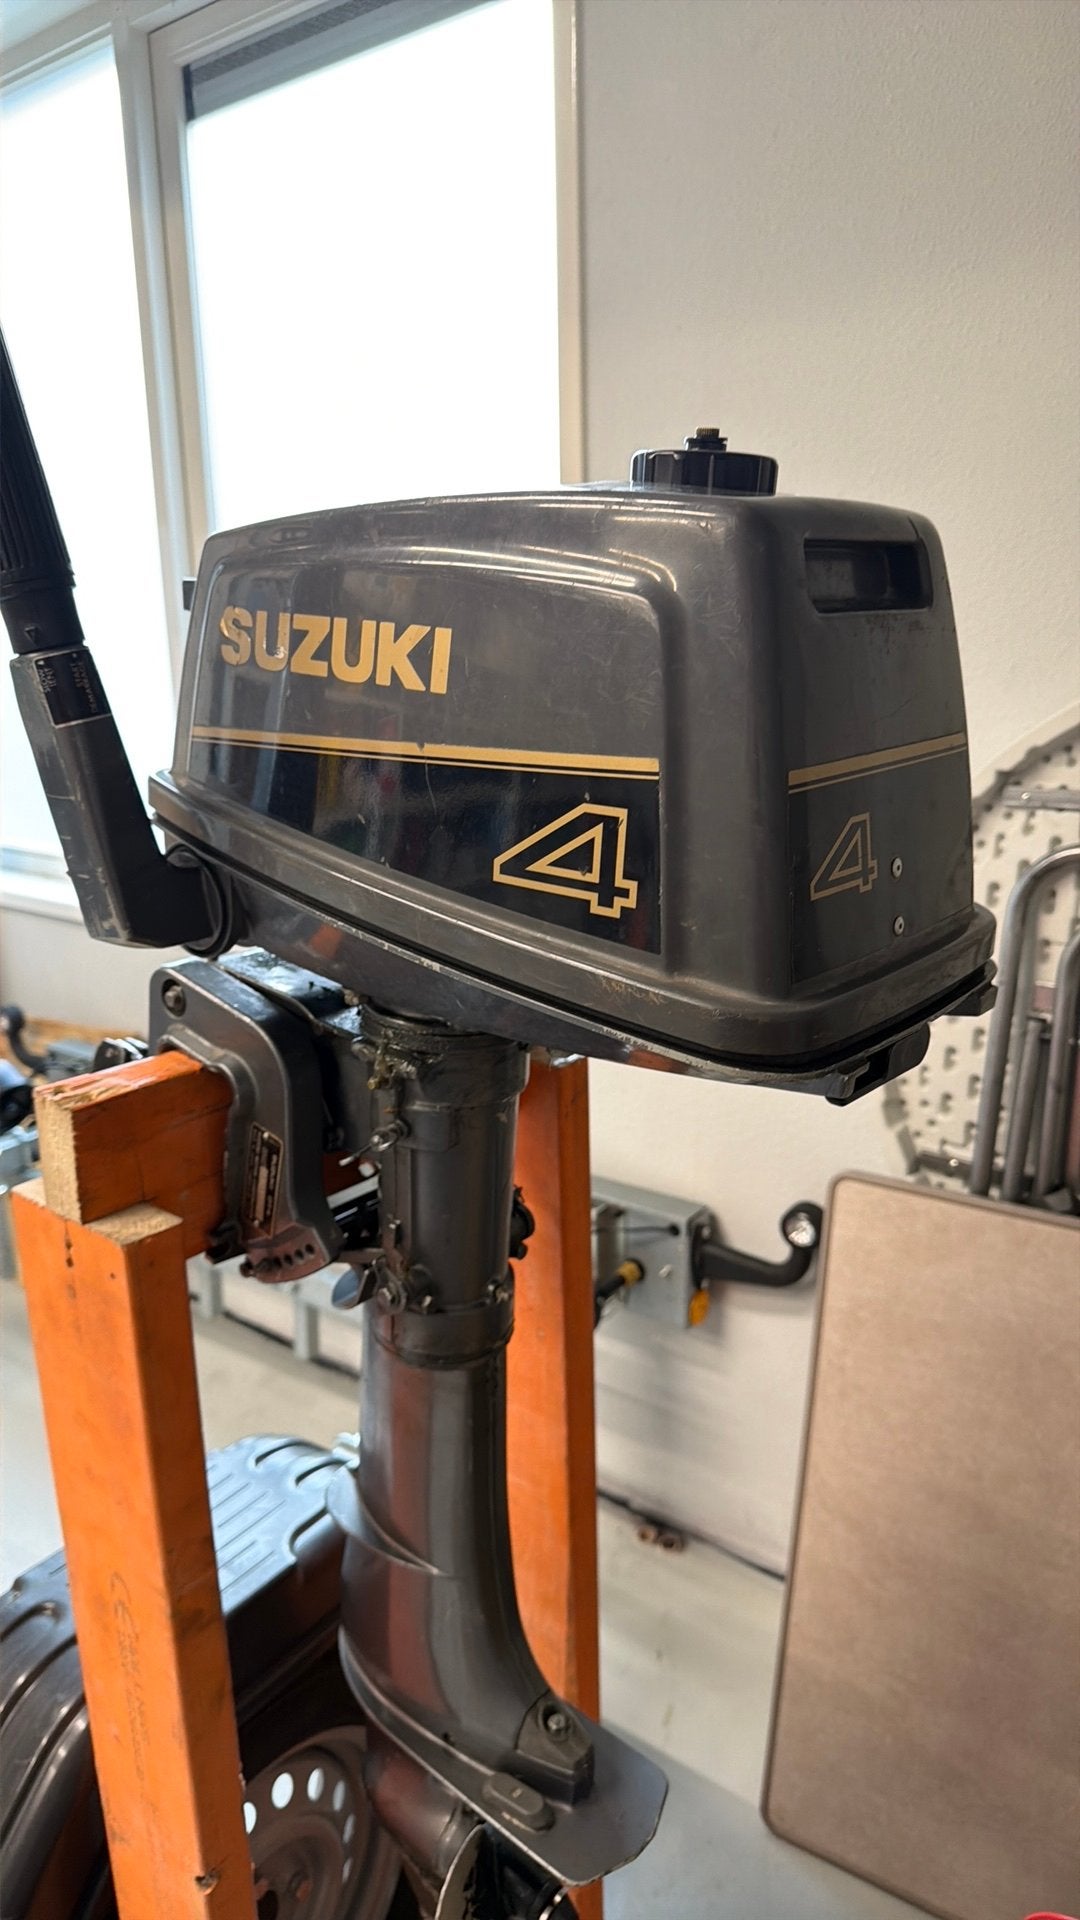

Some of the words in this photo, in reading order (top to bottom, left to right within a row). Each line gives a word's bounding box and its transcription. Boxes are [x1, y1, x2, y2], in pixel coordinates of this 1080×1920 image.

[220, 606, 453, 695] SUZUKI
[492, 802, 639, 919] 4
[809, 812, 878, 902] 4
